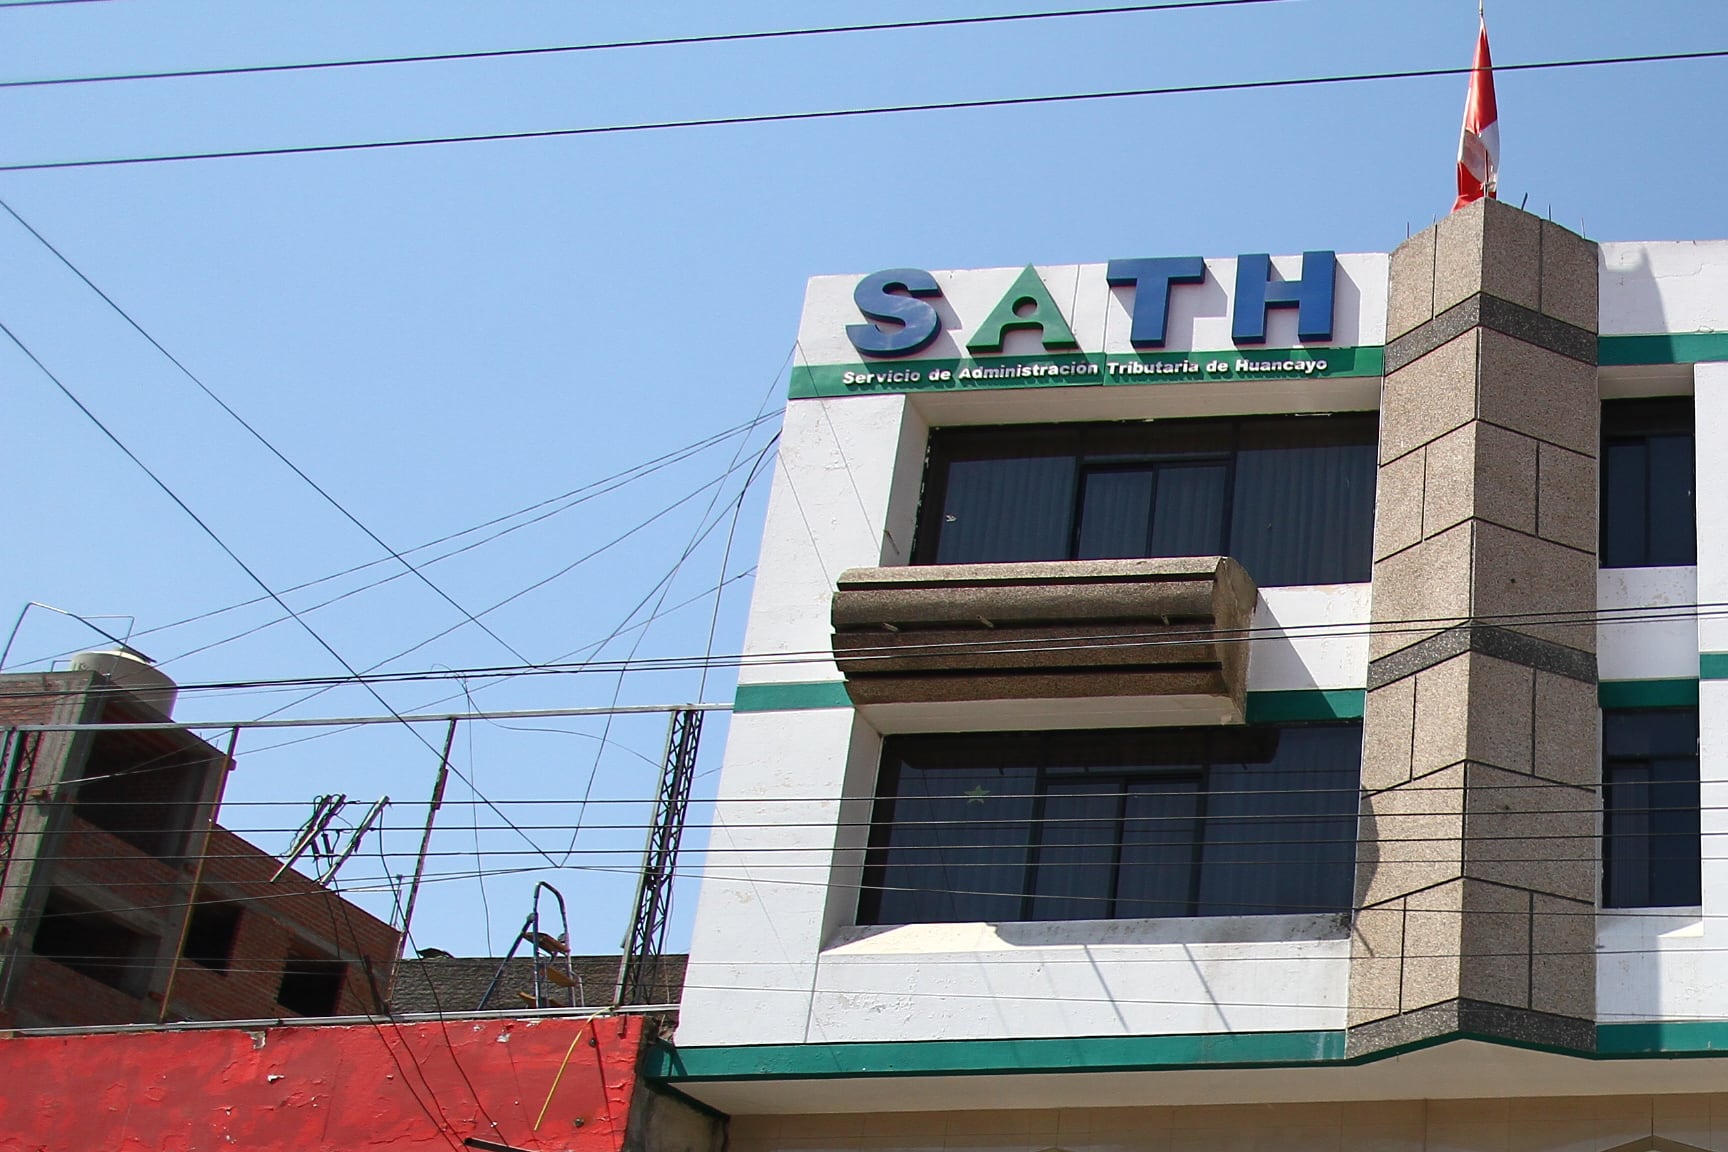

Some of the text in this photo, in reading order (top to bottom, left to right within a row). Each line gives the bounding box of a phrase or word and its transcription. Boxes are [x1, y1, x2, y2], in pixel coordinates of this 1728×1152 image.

[845, 251, 1336, 358] SATH
[842, 356, 1327, 385] Servicio de Administración Tributaria de Huancayo
